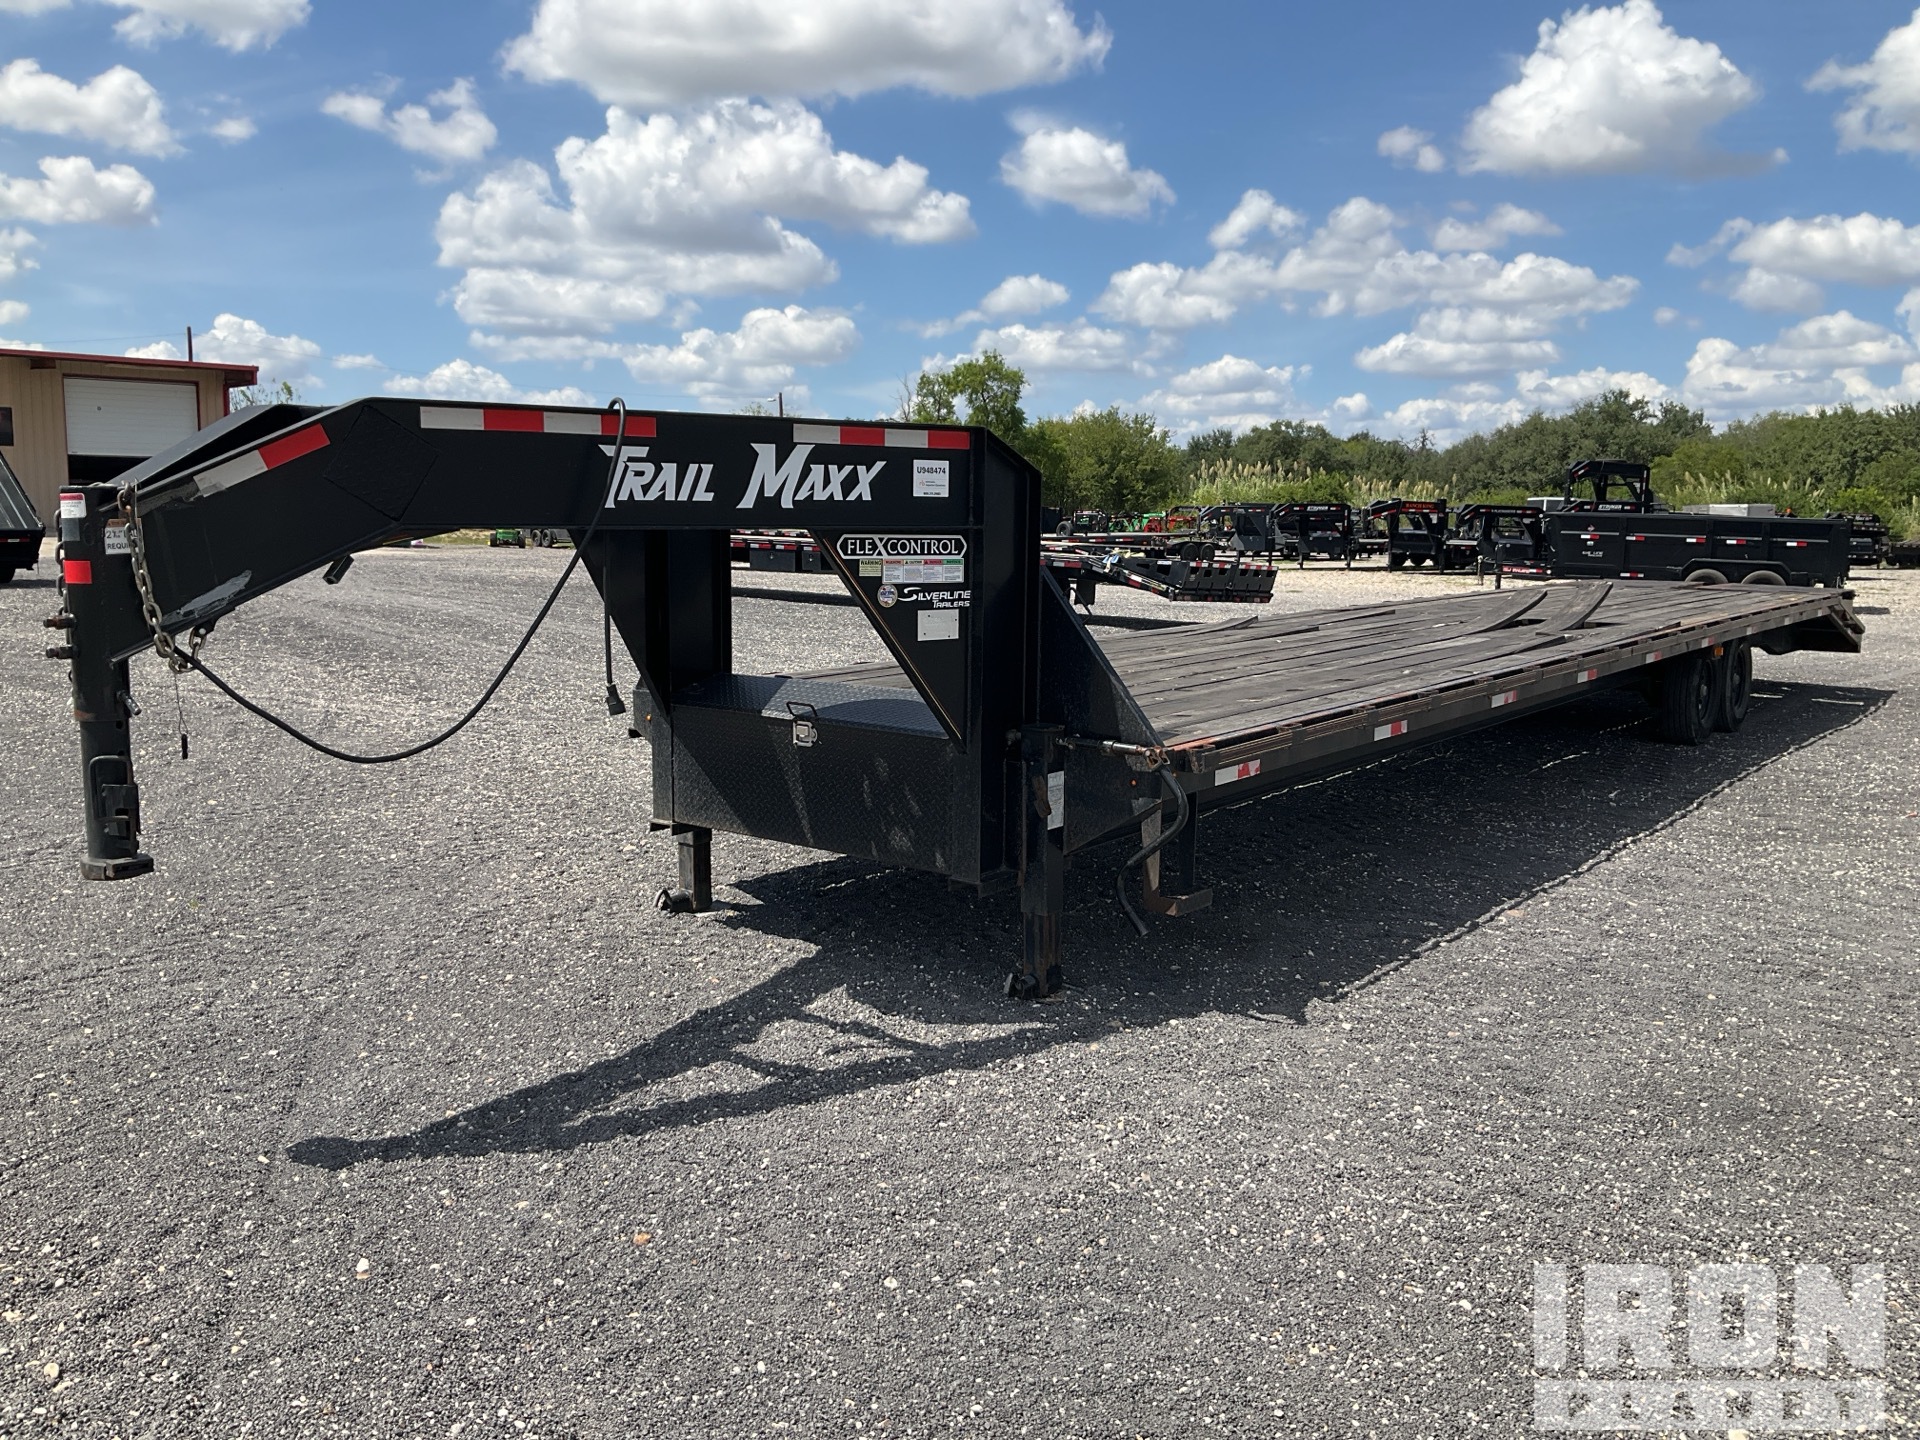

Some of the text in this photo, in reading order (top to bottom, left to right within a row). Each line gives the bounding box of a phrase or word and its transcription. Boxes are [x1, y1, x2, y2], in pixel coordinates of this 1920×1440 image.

[598, 443, 886, 509] TRAIL MAXX
[916, 466, 947, 475] U948474
[898, 587, 971, 602] SILVERLINE
[932, 600, 970, 609] TRAILERS
